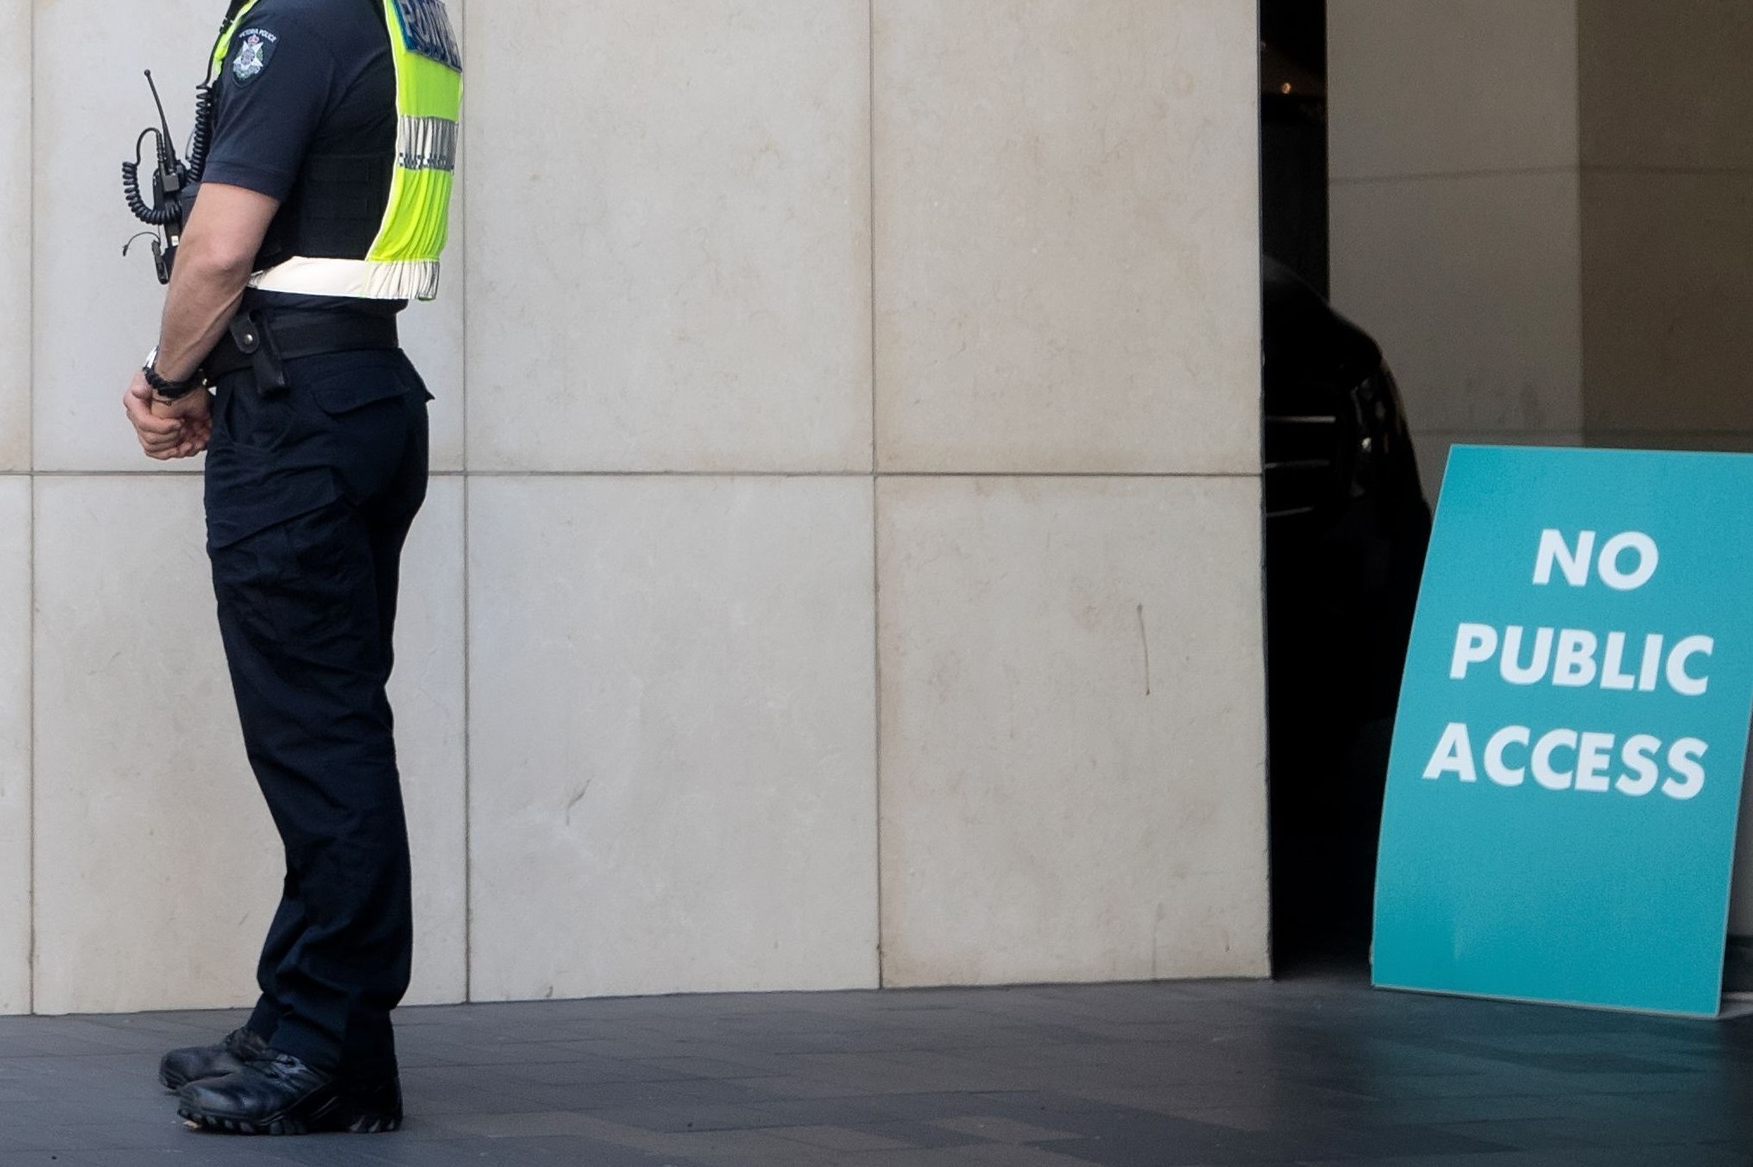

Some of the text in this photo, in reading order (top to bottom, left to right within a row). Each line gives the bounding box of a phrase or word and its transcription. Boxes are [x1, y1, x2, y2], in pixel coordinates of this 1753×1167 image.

[1532, 528, 1660, 591] NO
[1449, 622, 1715, 696] PUBLIC
[1422, 721, 1709, 800] ACCESS
